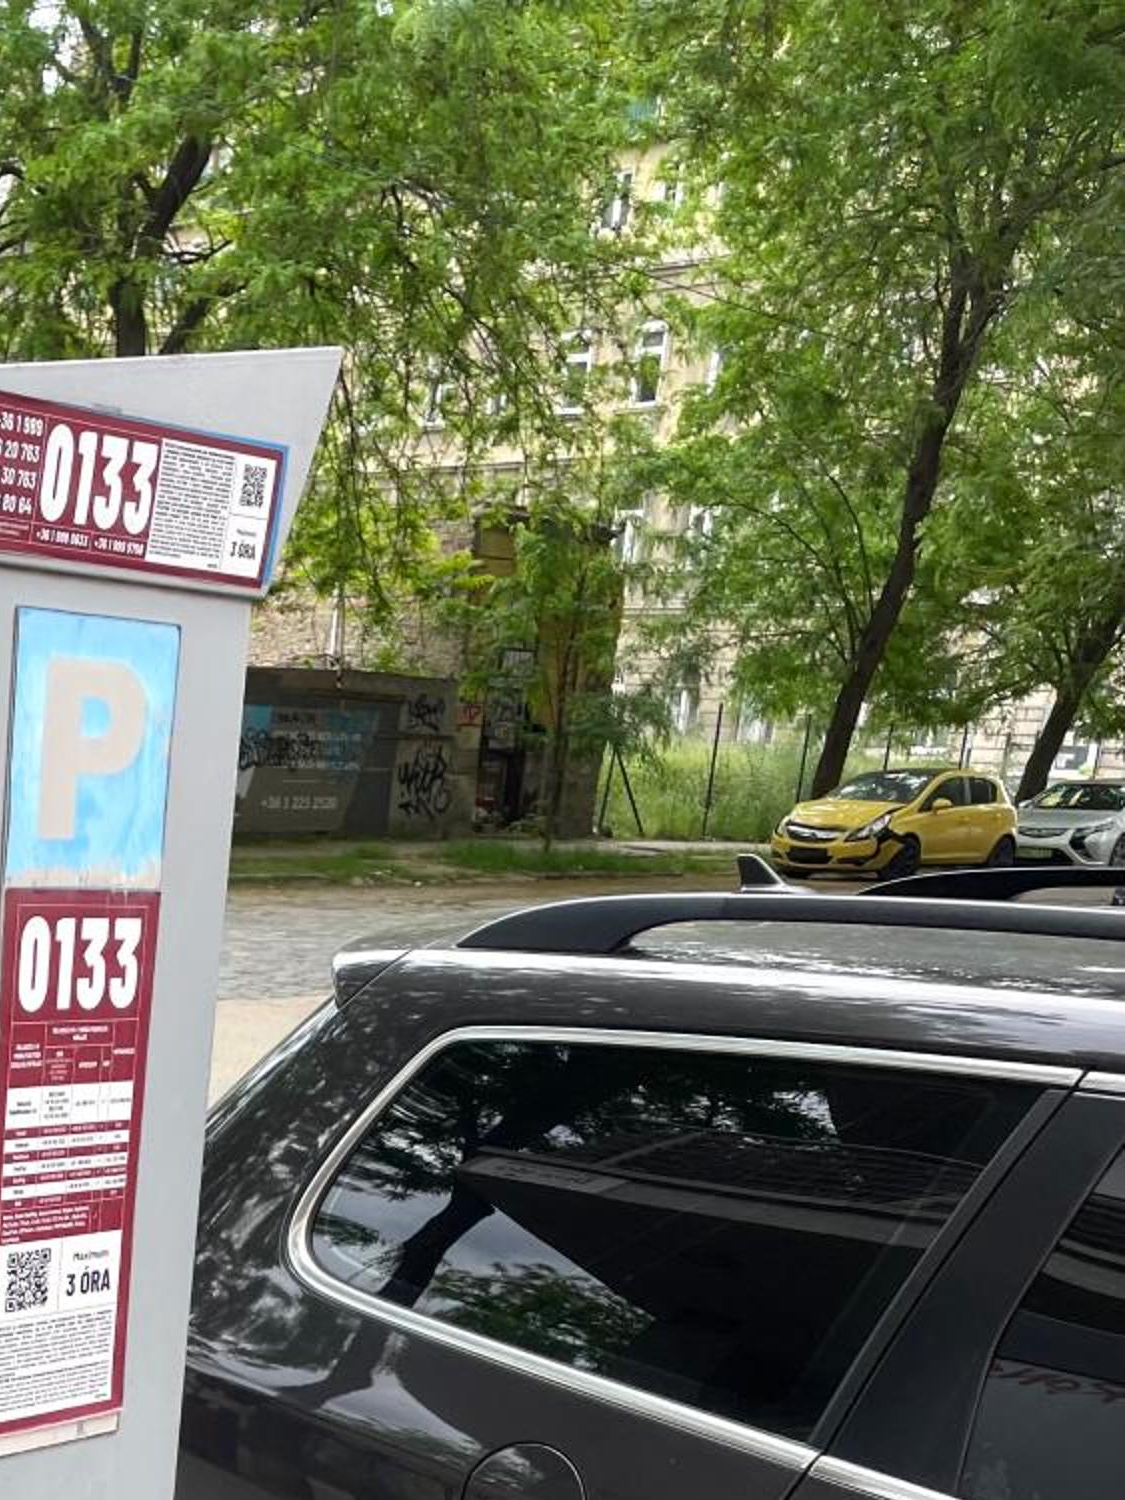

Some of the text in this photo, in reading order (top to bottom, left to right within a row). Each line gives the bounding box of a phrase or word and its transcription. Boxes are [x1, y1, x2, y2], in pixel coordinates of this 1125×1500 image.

[40, 424, 159, 535] 0133
[39, 657, 147, 839] P
[19, 916, 142, 1012] 0133
[66, 1266, 110, 1296] 3 ÓRA
